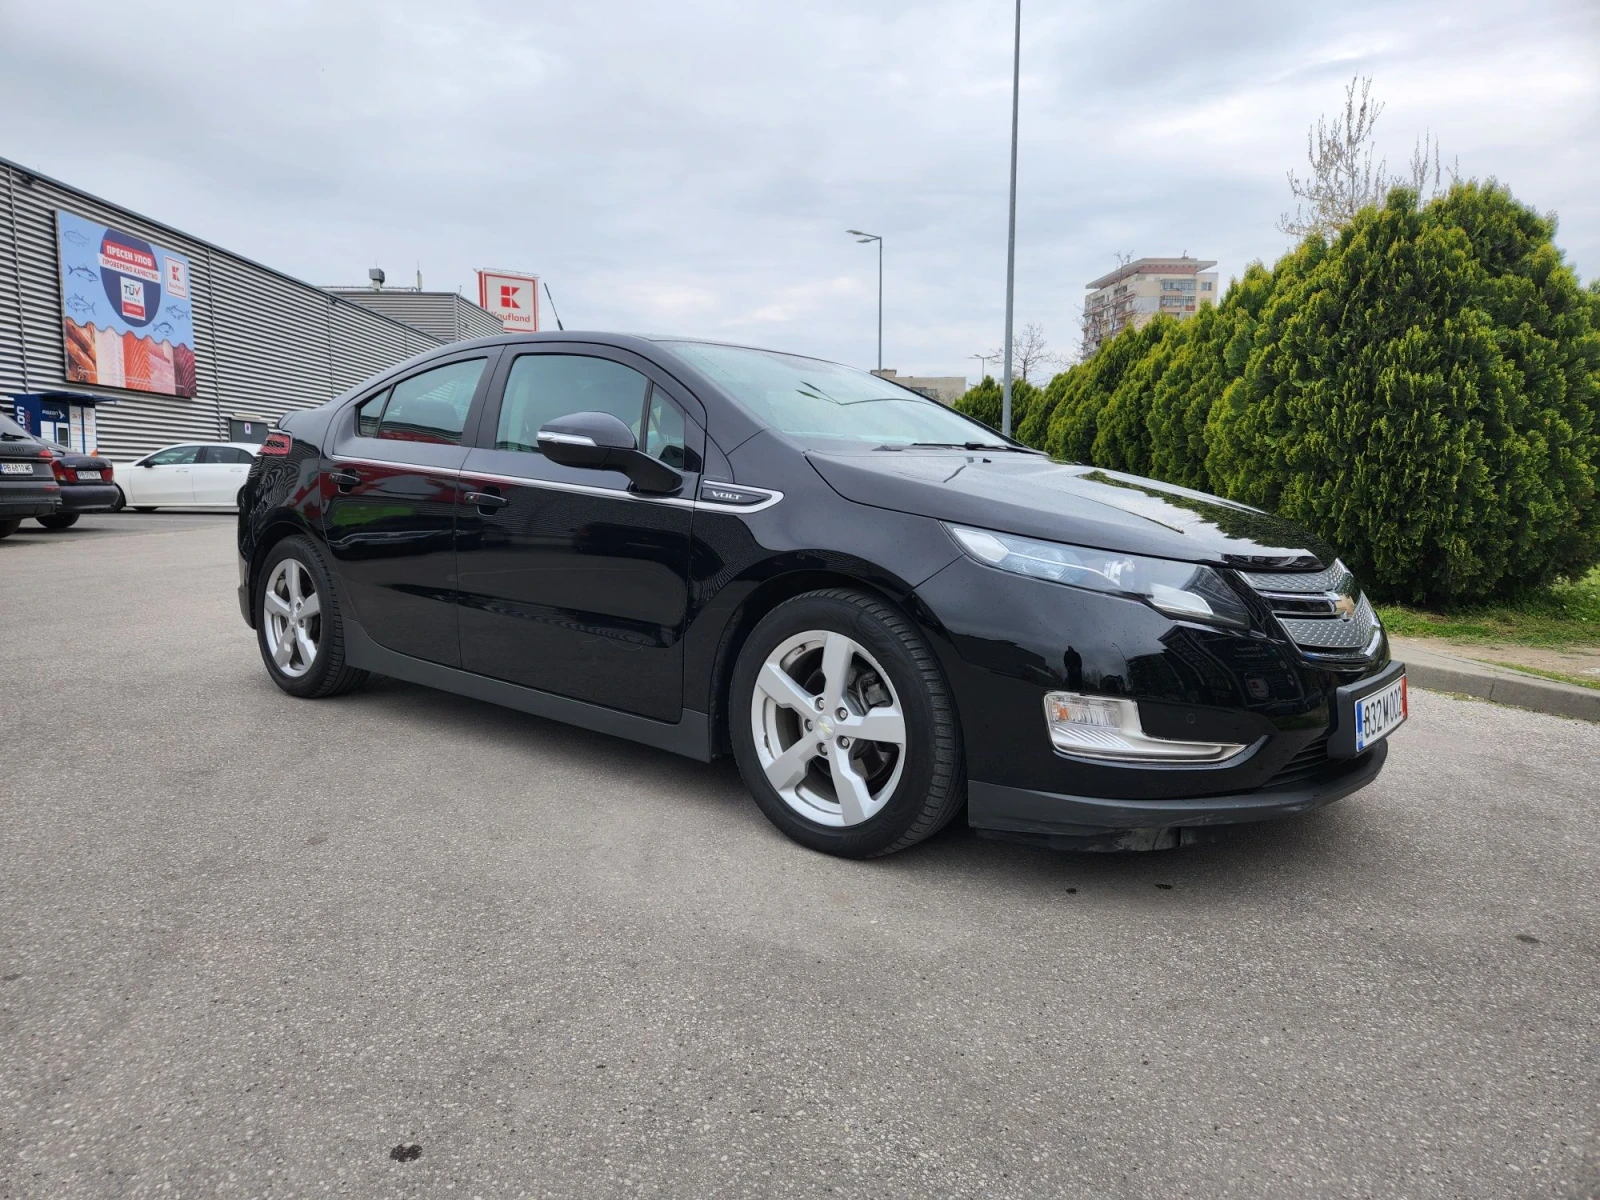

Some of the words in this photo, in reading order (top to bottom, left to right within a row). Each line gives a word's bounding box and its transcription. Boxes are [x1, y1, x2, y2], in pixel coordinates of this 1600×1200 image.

[106, 245, 133, 260] ПРЕСЕН
[134, 253, 152, 267] УЛОВ
[102, 258, 132, 273] ПРОВЕРЕНО
[133, 267, 158, 280] КАЧЕСТВО
[711, 490, 742, 500] VOLT
